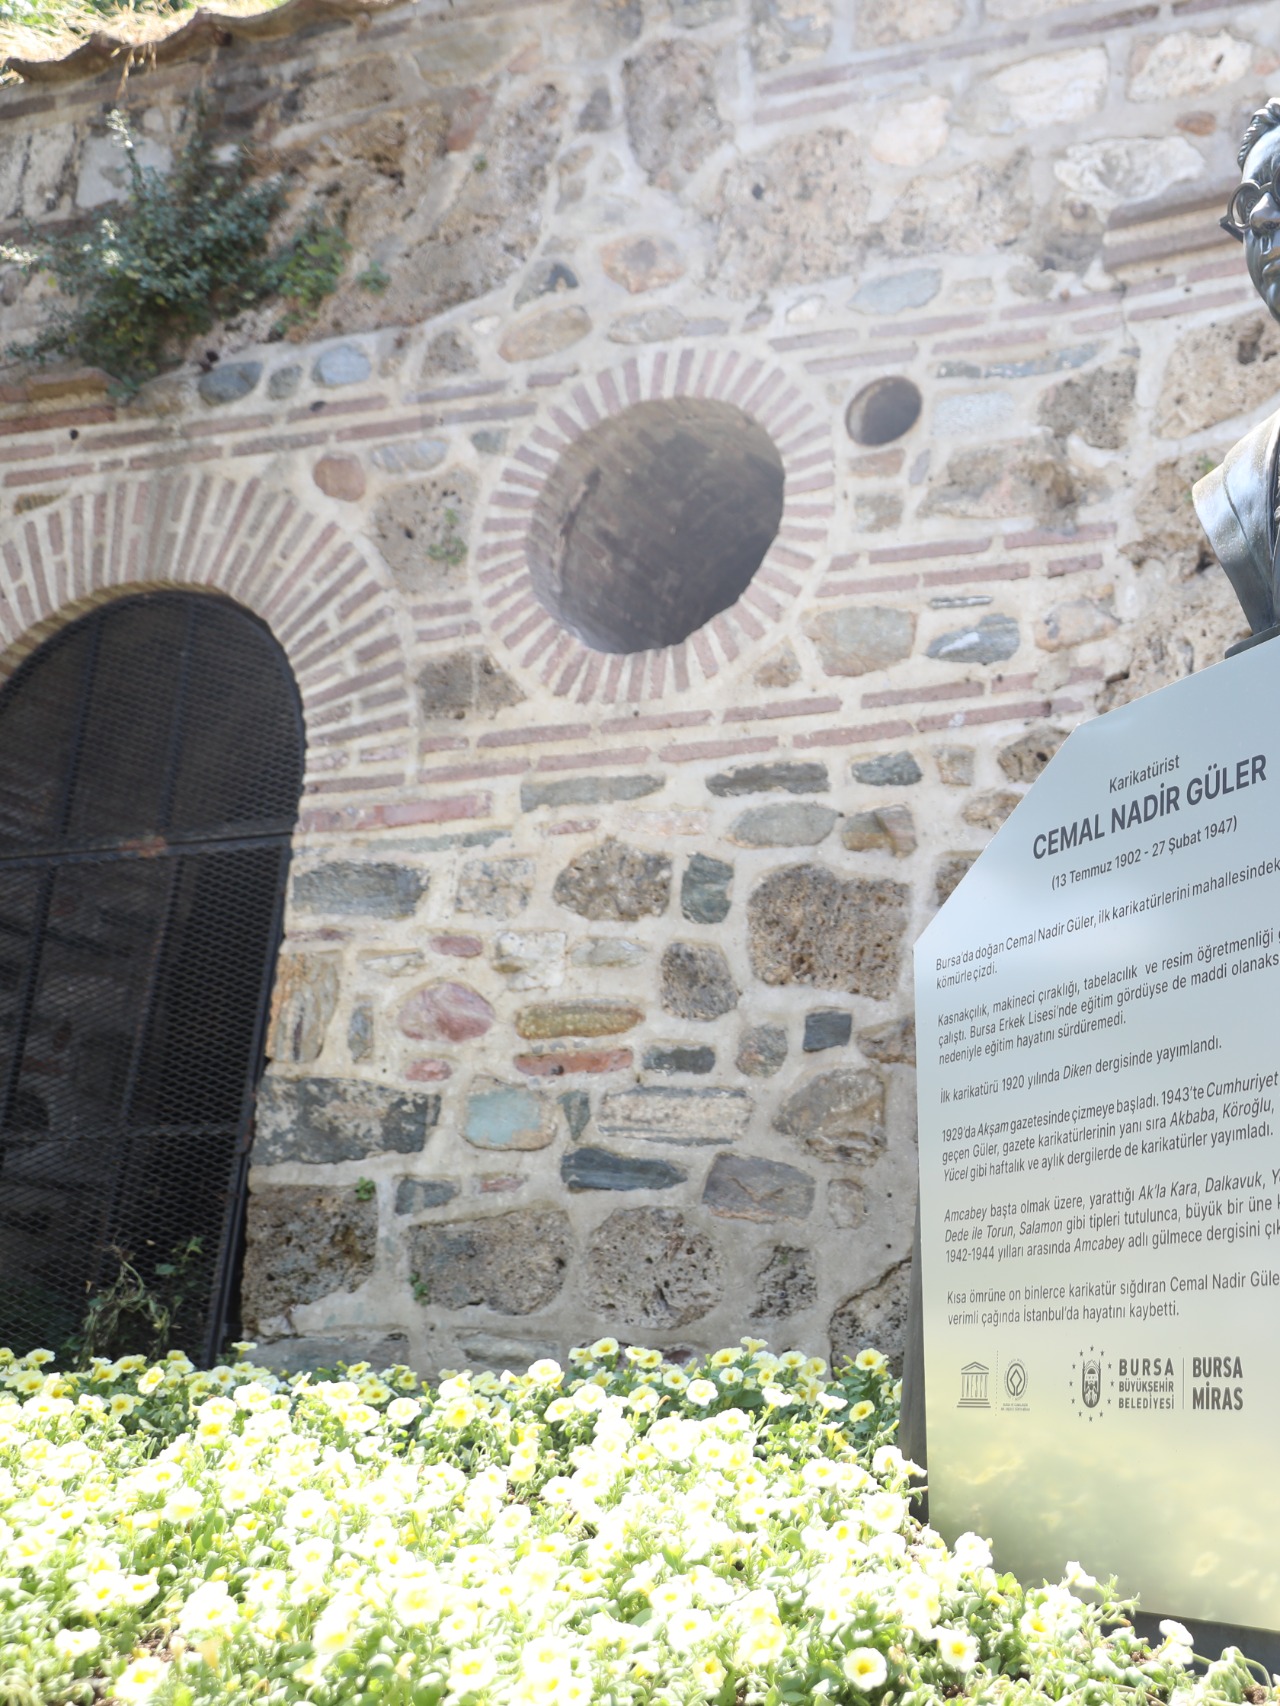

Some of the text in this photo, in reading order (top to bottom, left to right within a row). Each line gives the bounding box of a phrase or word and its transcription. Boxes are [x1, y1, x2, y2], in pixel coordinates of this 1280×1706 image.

[1108, 753, 1181, 795] Karikatürist
[1031, 753, 1268, 860] CEMAL NADİR GÜLER
[1050, 872, 1068, 892] (13
[1068, 859, 1113, 885] Temmuz
[1113, 847, 1142, 870] 1902
[1150, 838, 1166, 858] 27
[1167, 828, 1202, 856] Şubat
[1203, 813, 1238, 840] 1947)
[974, 941, 1005, 961] doğan
[1004, 929, 1037, 952] Cemal
[1036, 921, 1066, 942] Nadir
[1065, 914, 1097, 934] Güler,
[1097, 907, 1111, 925] ilk
[1111, 882, 1191, 921] karikatürlerini
[935, 959, 998, 990] kömürle çizdi.
[936, 1002, 990, 1027] Kasnakçılık,
[991, 988, 1036, 1014] makineci
[1036, 979, 1081, 1006] çıraklığı,
[1082, 963, 1139, 991] tabelacılık
[1143, 960, 1159, 976] ve
[1160, 950, 1194, 972] resim
[1196, 926, 1274, 965] öğretmenliği
[937, 1028, 967, 1049] çalıştı.
[968, 1022, 997, 1040] Bursa
[998, 1012, 1026, 1033] Erkek
[1079, 992, 1114, 1015] eğitim
[1115, 980, 1169, 1008] gördüyse
[1171, 973, 1188, 991] de
[1189, 961, 1228, 987] maddi
[938, 1008, 1127, 1066] nedeniyle eğitim hayatını sürdüremedi.
[939, 1033, 1223, 1104] İlk karikatürü 1920 yılında Diken dergisinde yayımlandı.
[975, 1120, 1010, 1139] Akşam
[1008, 1107, 1071, 1136] gazetesinde
[1070, 1102, 1116, 1126] çizmeye
[1115, 1091, 1160, 1116] başladı.
[1205, 1070, 1280, 1099] Cumhuriyet
[941, 1147, 971, 1167] geçen
[971, 1141, 1000, 1159] Güler,
[1001, 1135, 1036, 1157] gazete
[1037, 1121, 1117, 1149] karikatürlerinin
[1118, 1119, 1143, 1140] yanı
[1144, 1115, 1167, 1132] sıra
[1168, 1105, 1219, 1128] Akbaba,
[1221, 1095, 1275, 1120] Köroğlu,
[942, 1119, 1274, 1183] Yücel gibi haftalık ve aylık dergilerde de karikatürler yayımladı.
[942, 1205, 988, 1223] Amcabey
[989, 1201, 1018, 1220] başta
[1019, 1196, 1051, 1215] olmak
[1052, 1194, 1086, 1211] üzere,
[1088, 1186, 1136, 1211] yarattığı
[1169, 1180, 1201, 1198] Kara,
[1203, 1170, 1266, 1194] Dalkavuk,
[943, 1226, 970, 1244] Dede
[970, 1225, 984, 1241] ile
[985, 1223, 1017, 1240] Torun,
[1018, 1219, 1064, 1237] Salamon
[1065, 1213, 1087, 1235] gibi
[1088, 1209, 1121, 1232] tipleri
[1122, 1206, 1182, 1226] tutulunca,
[1184, 1199, 1224, 1222] büyük
[1226, 1196, 1245, 1216] bir
[1247, 1194, 1273, 1214] üne
[944, 1244, 996, 1264] 1942-1944
[996, 1242, 1025, 1263] yılları
[1025, 1238, 1072, 1257] arasında
[1072, 1234, 1126, 1254] Amcabey
[1126, 1230, 1149, 1249] adlı
[1150, 1228, 1203, 1251] gülmece
[1205, 1218, 1261, 1244] dergisini
[946, 1290, 967, 1305] Kısa
[968, 1286, 1007, 1304] ömrüne
[1007, 1288, 1022, 1302] on
[1023, 1284, 1066, 1301] binlerce
[1067, 1279, 1117, 1299] karikatür
[1119, 1277, 1167, 1299] sığdıran
[1168, 1273, 1209, 1293] Cemal
[1211, 1270, 1247, 1290] Nadir
[947, 1309, 980, 1326] verimli
[980, 1307, 1021, 1328] çağında
[1081, 1303, 1127, 1324] hayatını
[1128, 1298, 1180, 1322] kaybetti.
[1118, 1357, 1175, 1376] BURSA
[1118, 1377, 1175, 1395] BÜYÜKŞEHİR
[1192, 1356, 1244, 1378] BURSA
[1118, 1394, 1175, 1410] BELEDİYESİ
[1192, 1381, 1244, 1411] MİRAS
